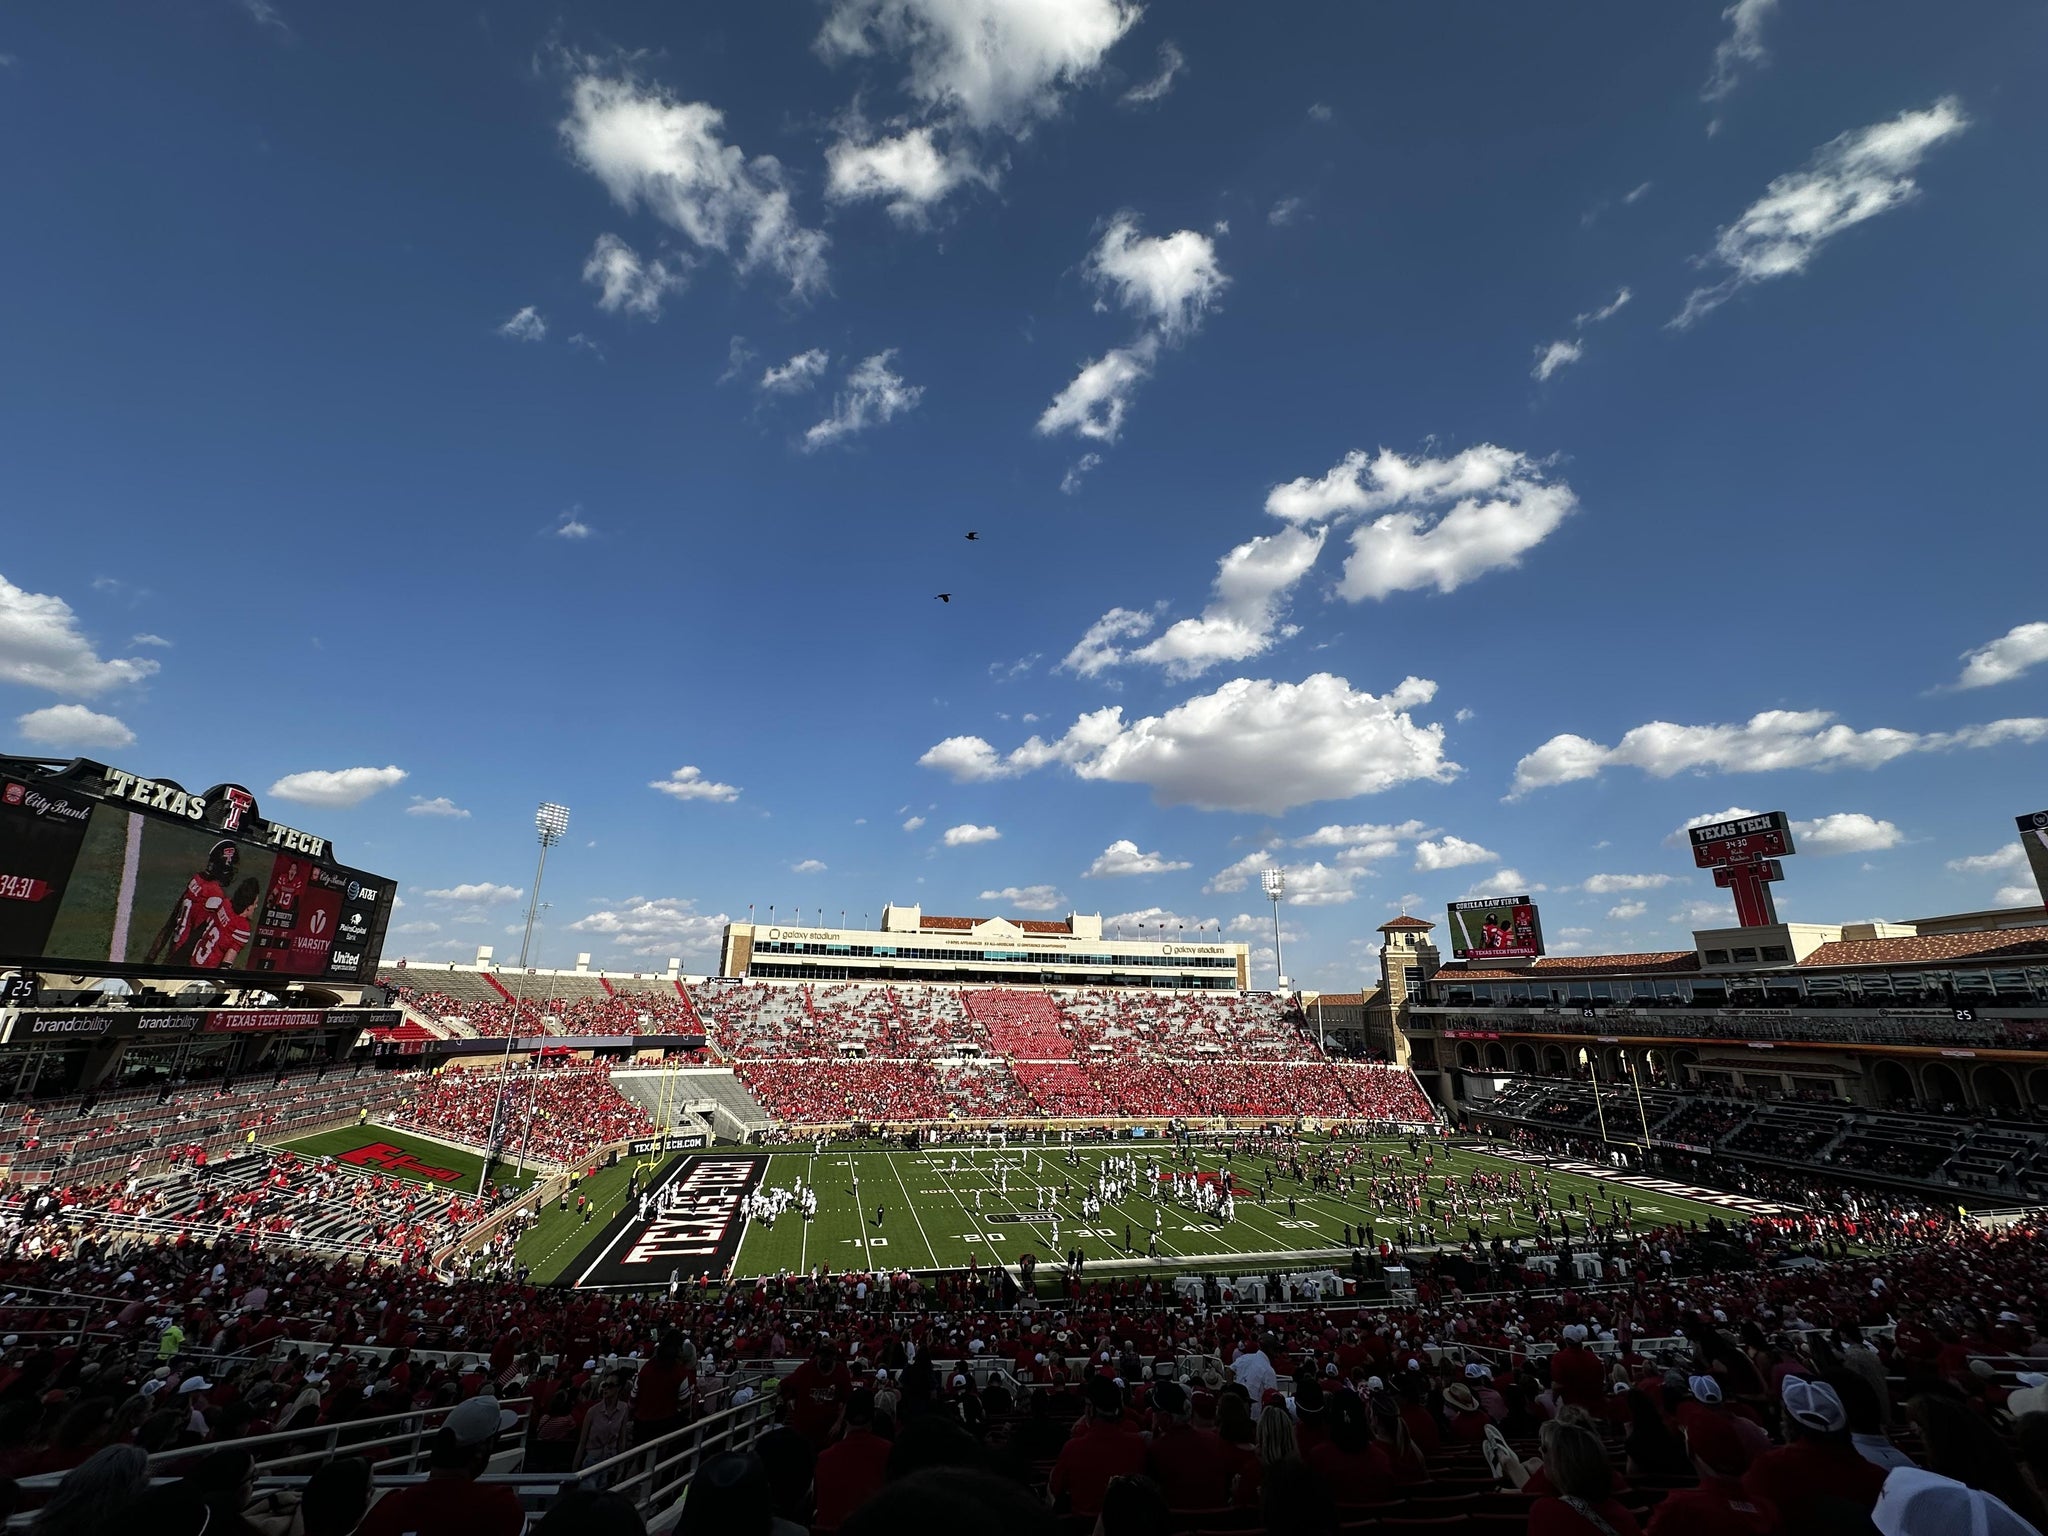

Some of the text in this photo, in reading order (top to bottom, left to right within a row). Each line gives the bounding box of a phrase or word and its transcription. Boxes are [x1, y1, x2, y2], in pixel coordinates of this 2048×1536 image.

[112, 769, 207, 820] TEXAS
[25, 790, 91, 820] City Bank
[1696, 816, 1773, 841] TEXAS TECH
[272, 824, 325, 857] TECH
[0, 874, 34, 898] 34:31
[358, 887, 378, 901] AT&T
[1484, 899, 1500, 907] LAW
[1500, 897, 1520, 906] FIRM
[782, 930, 840, 941] galaxy stadium
[297, 936, 331, 951] VARSITY
[1197, 945, 1225, 954] stadium
[1506, 947, 1535, 955] FOOTBALL
[332, 950, 361, 965] United
[11, 981, 33, 997] 25
[226, 1013, 320, 1028] TEXAS TECH FOOTBALL
[1584, 1009, 1594, 1017] 25
[1956, 1009, 1972, 1020] 25
[32, 1016, 113, 1034] brandability
[138, 1014, 199, 1031] brandability
[634, 1138, 702, 1153] TEXASECH.COM
[679, 1161, 755, 1191] TECH
[620, 1195, 741, 1265] TEXAS
[1073, 1228, 1117, 1238] 30
[1182, 1223, 1222, 1233] 40
[853, 1237, 889, 1248] 10
[962, 1232, 1007, 1243] 20
